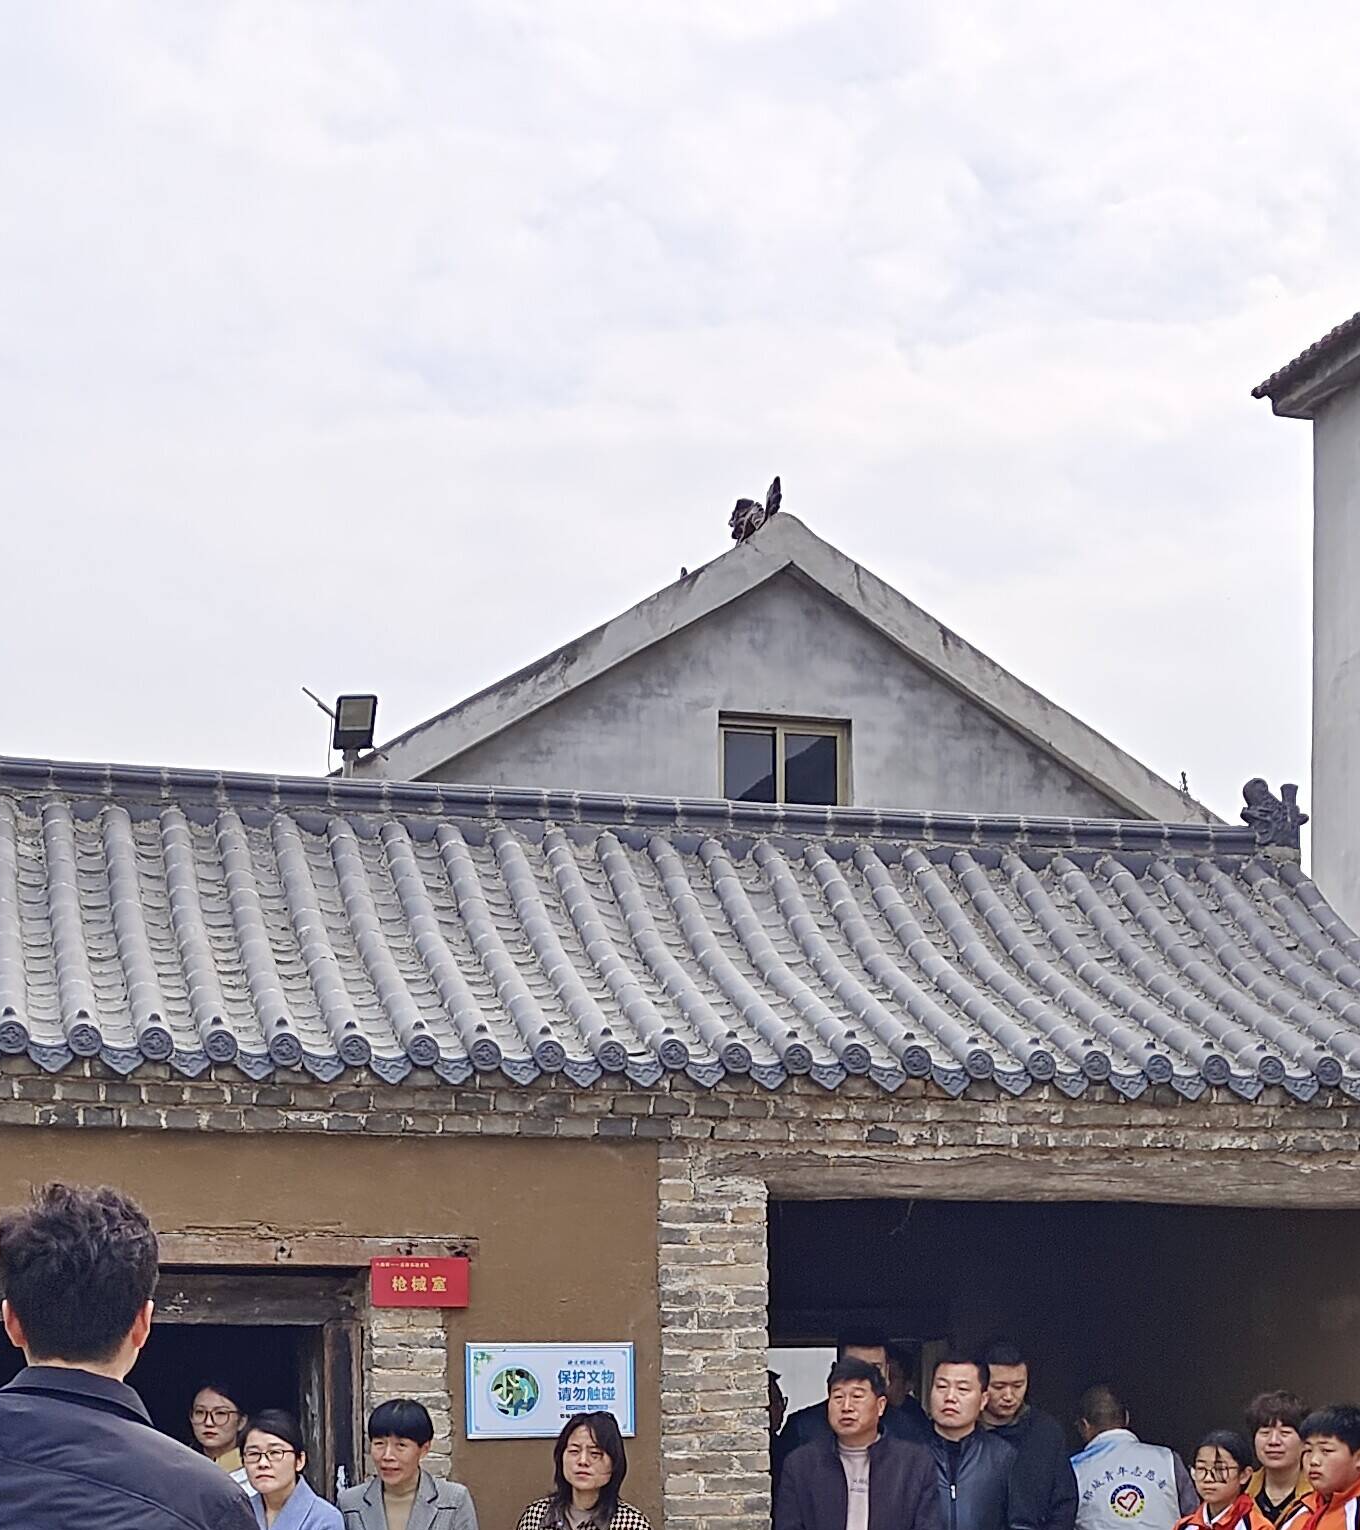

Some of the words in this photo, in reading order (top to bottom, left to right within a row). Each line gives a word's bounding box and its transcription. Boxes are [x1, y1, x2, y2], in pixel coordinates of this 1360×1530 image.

[391, 1275, 447, 1292] 枪械室
[557, 1369, 615, 1384] 保护文物
[557, 1386, 616, 1401] 请勿触碰
